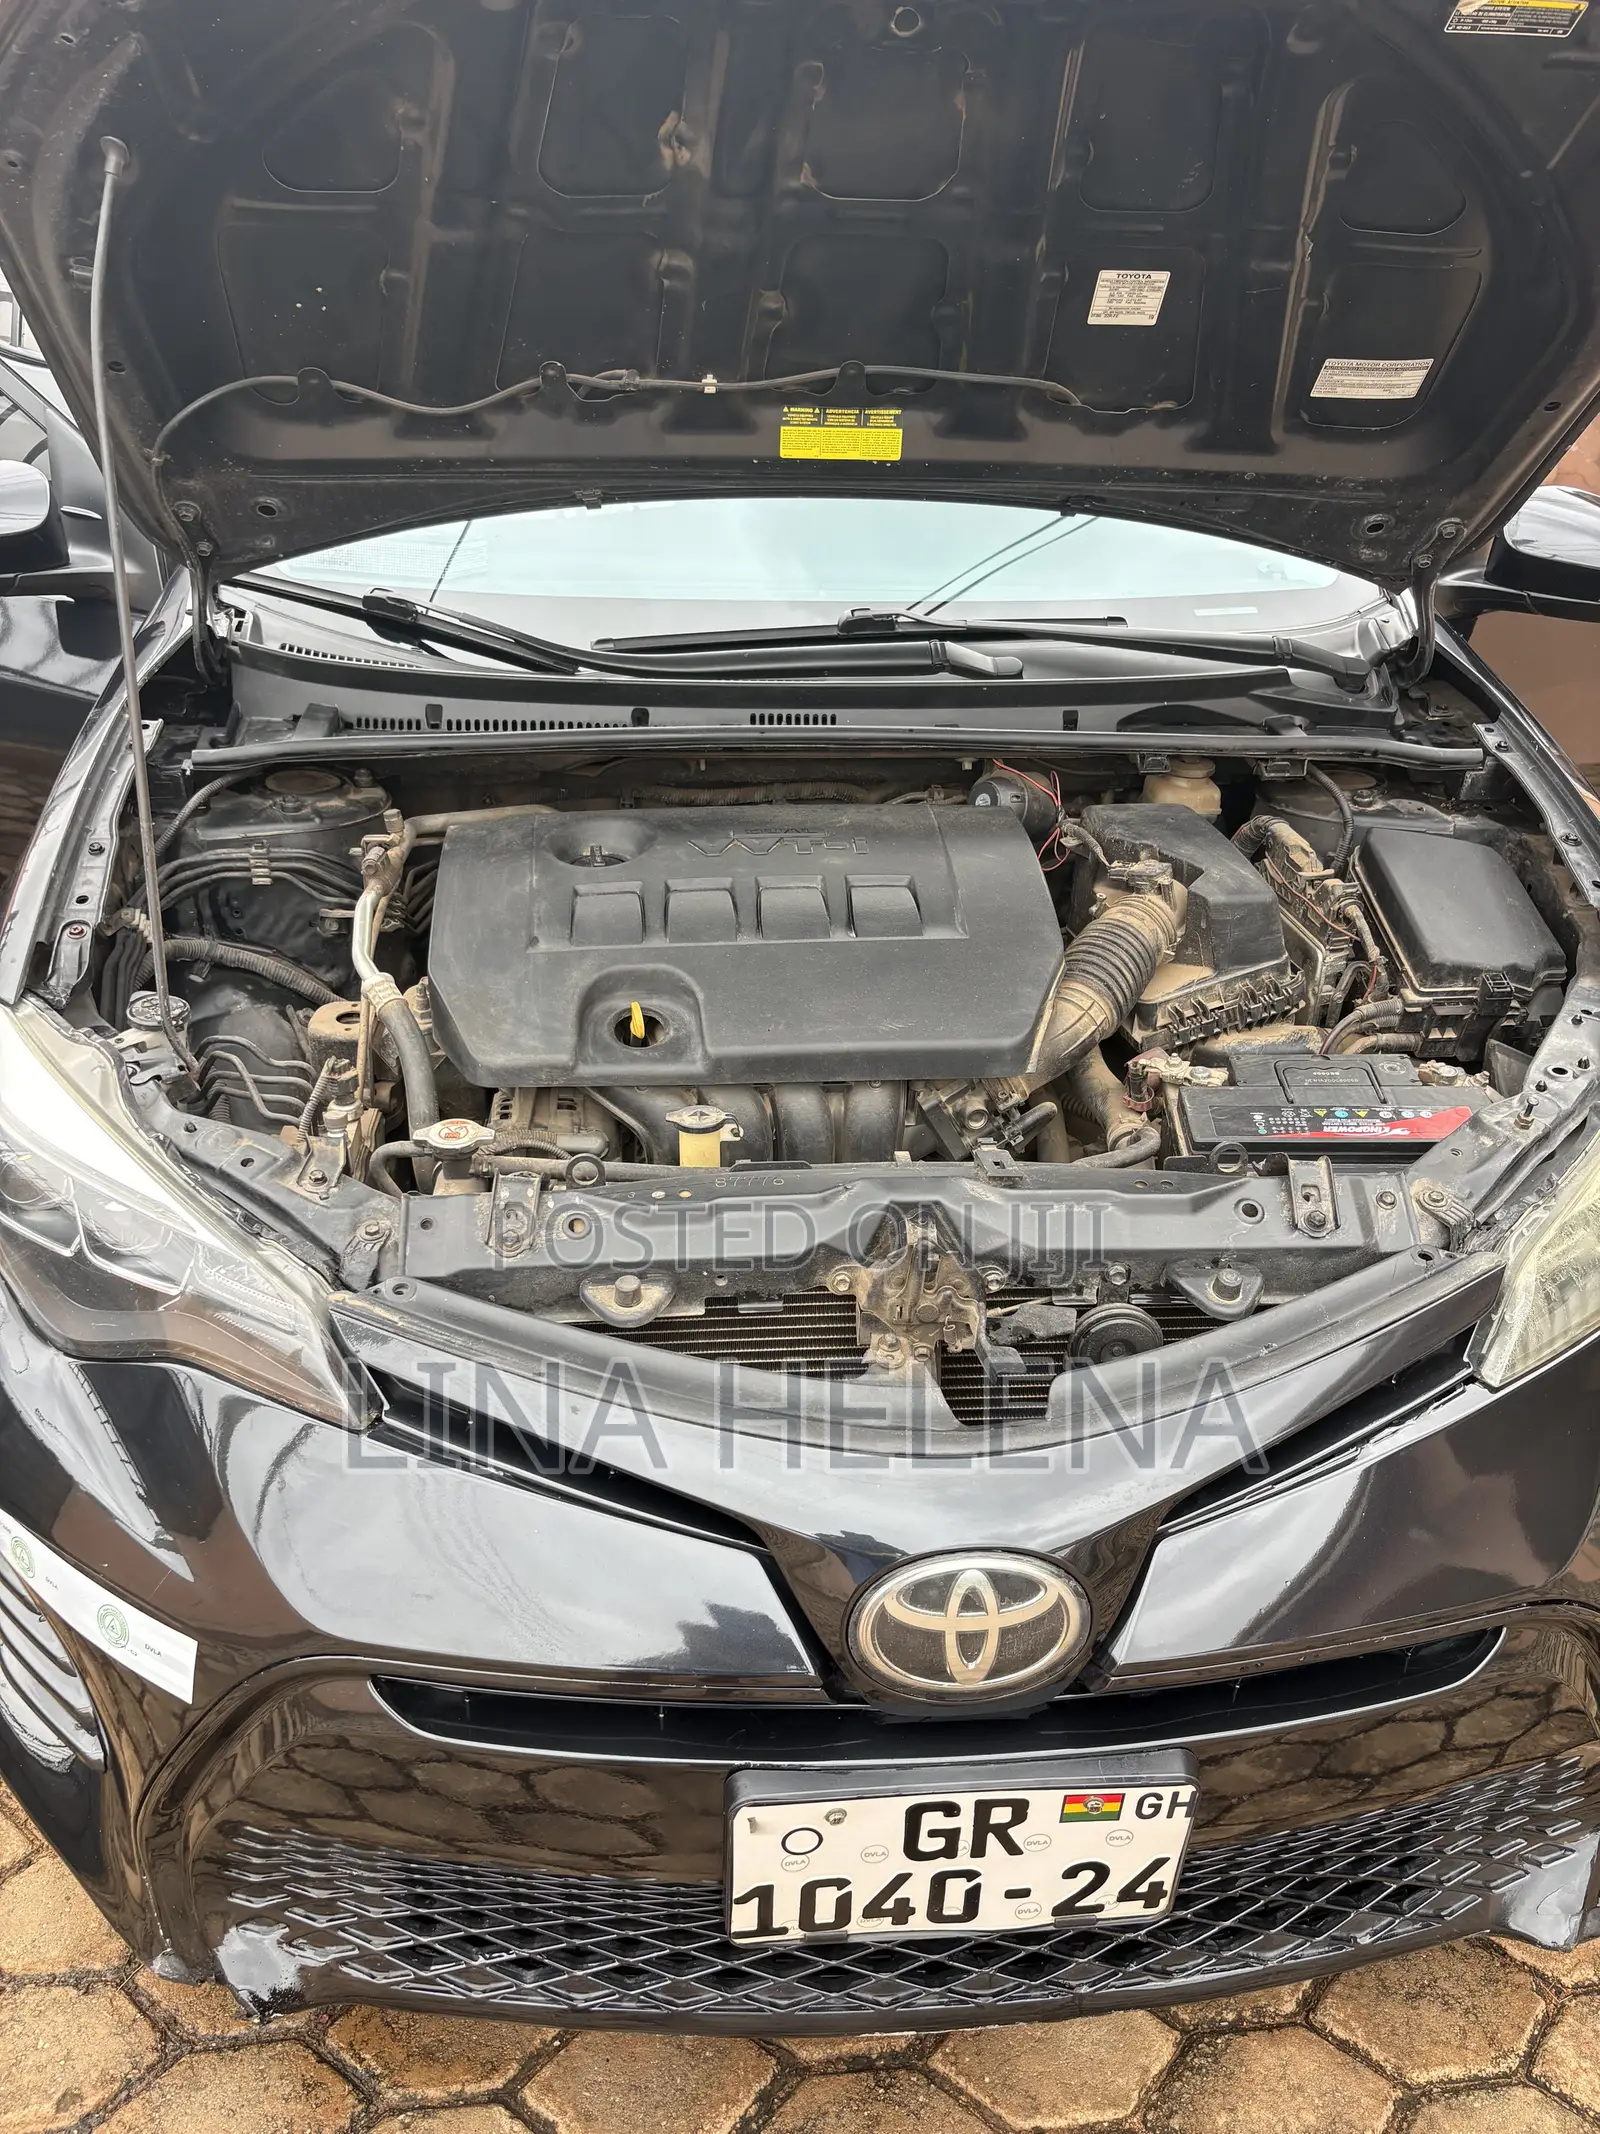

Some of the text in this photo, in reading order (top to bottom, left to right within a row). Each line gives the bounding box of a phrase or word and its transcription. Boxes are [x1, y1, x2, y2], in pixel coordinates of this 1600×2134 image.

[1322, 1125, 1391, 1134] KINGPOWER
[1135, 1791, 1198, 1820] GH
[903, 1798, 1030, 1862] GR
[784, 1858, 807, 1867] DVLA
